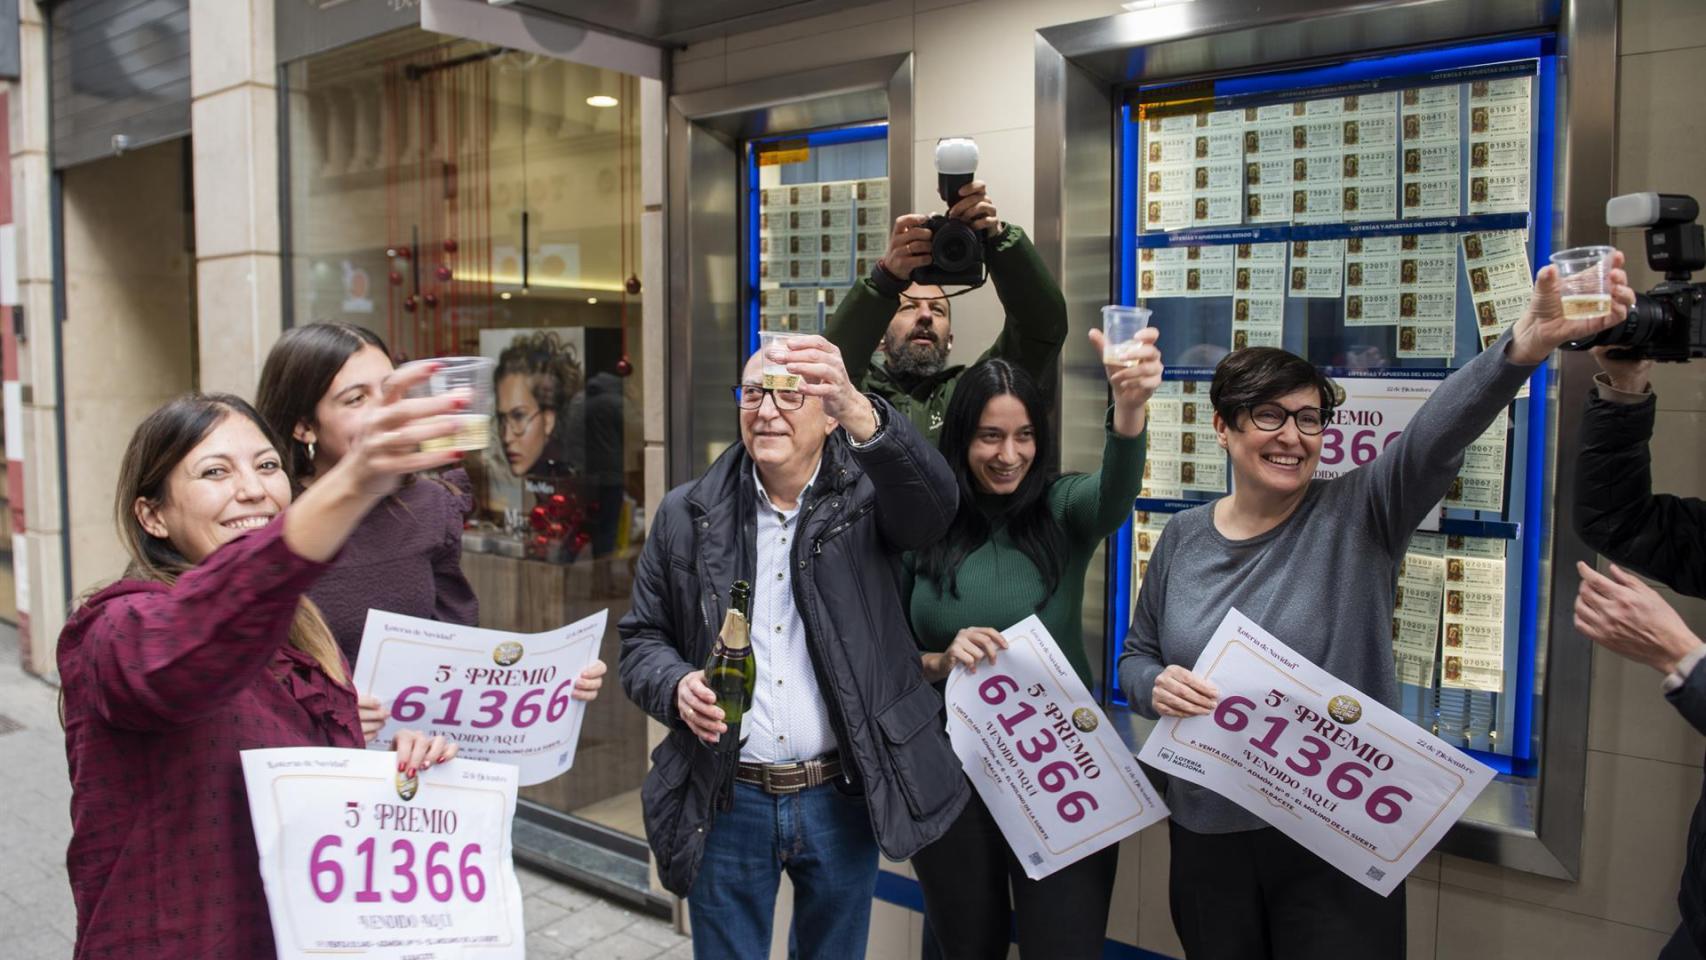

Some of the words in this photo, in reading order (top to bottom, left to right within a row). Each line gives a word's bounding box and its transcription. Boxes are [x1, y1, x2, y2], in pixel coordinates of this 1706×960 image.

[390, 678, 572, 729] 61366
[465, 665, 556, 687] PREMIO
[978, 674, 1099, 824] 61366
[986, 720, 1019, 769] VENDIDO
[1017, 768, 1039, 797] AQUÍ
[1044, 701, 1101, 780] PREMIO
[1172, 758, 1206, 776] NACIONAL
[1213, 695, 1413, 825] 61366
[1294, 703, 1394, 772] PREMIO
[1243, 749, 1301, 790] VENDIDO
[1302, 786, 1340, 813] AQUÍ
[1260, 787, 1296, 811] ALBACETE
[374, 802, 458, 836] PREMIO
[1303, 804, 1332, 823] MOLINO
[1330, 820, 1342, 831] DE
[1350, 832, 1378, 852] SUERTE
[309, 834, 487, 904] 61366
